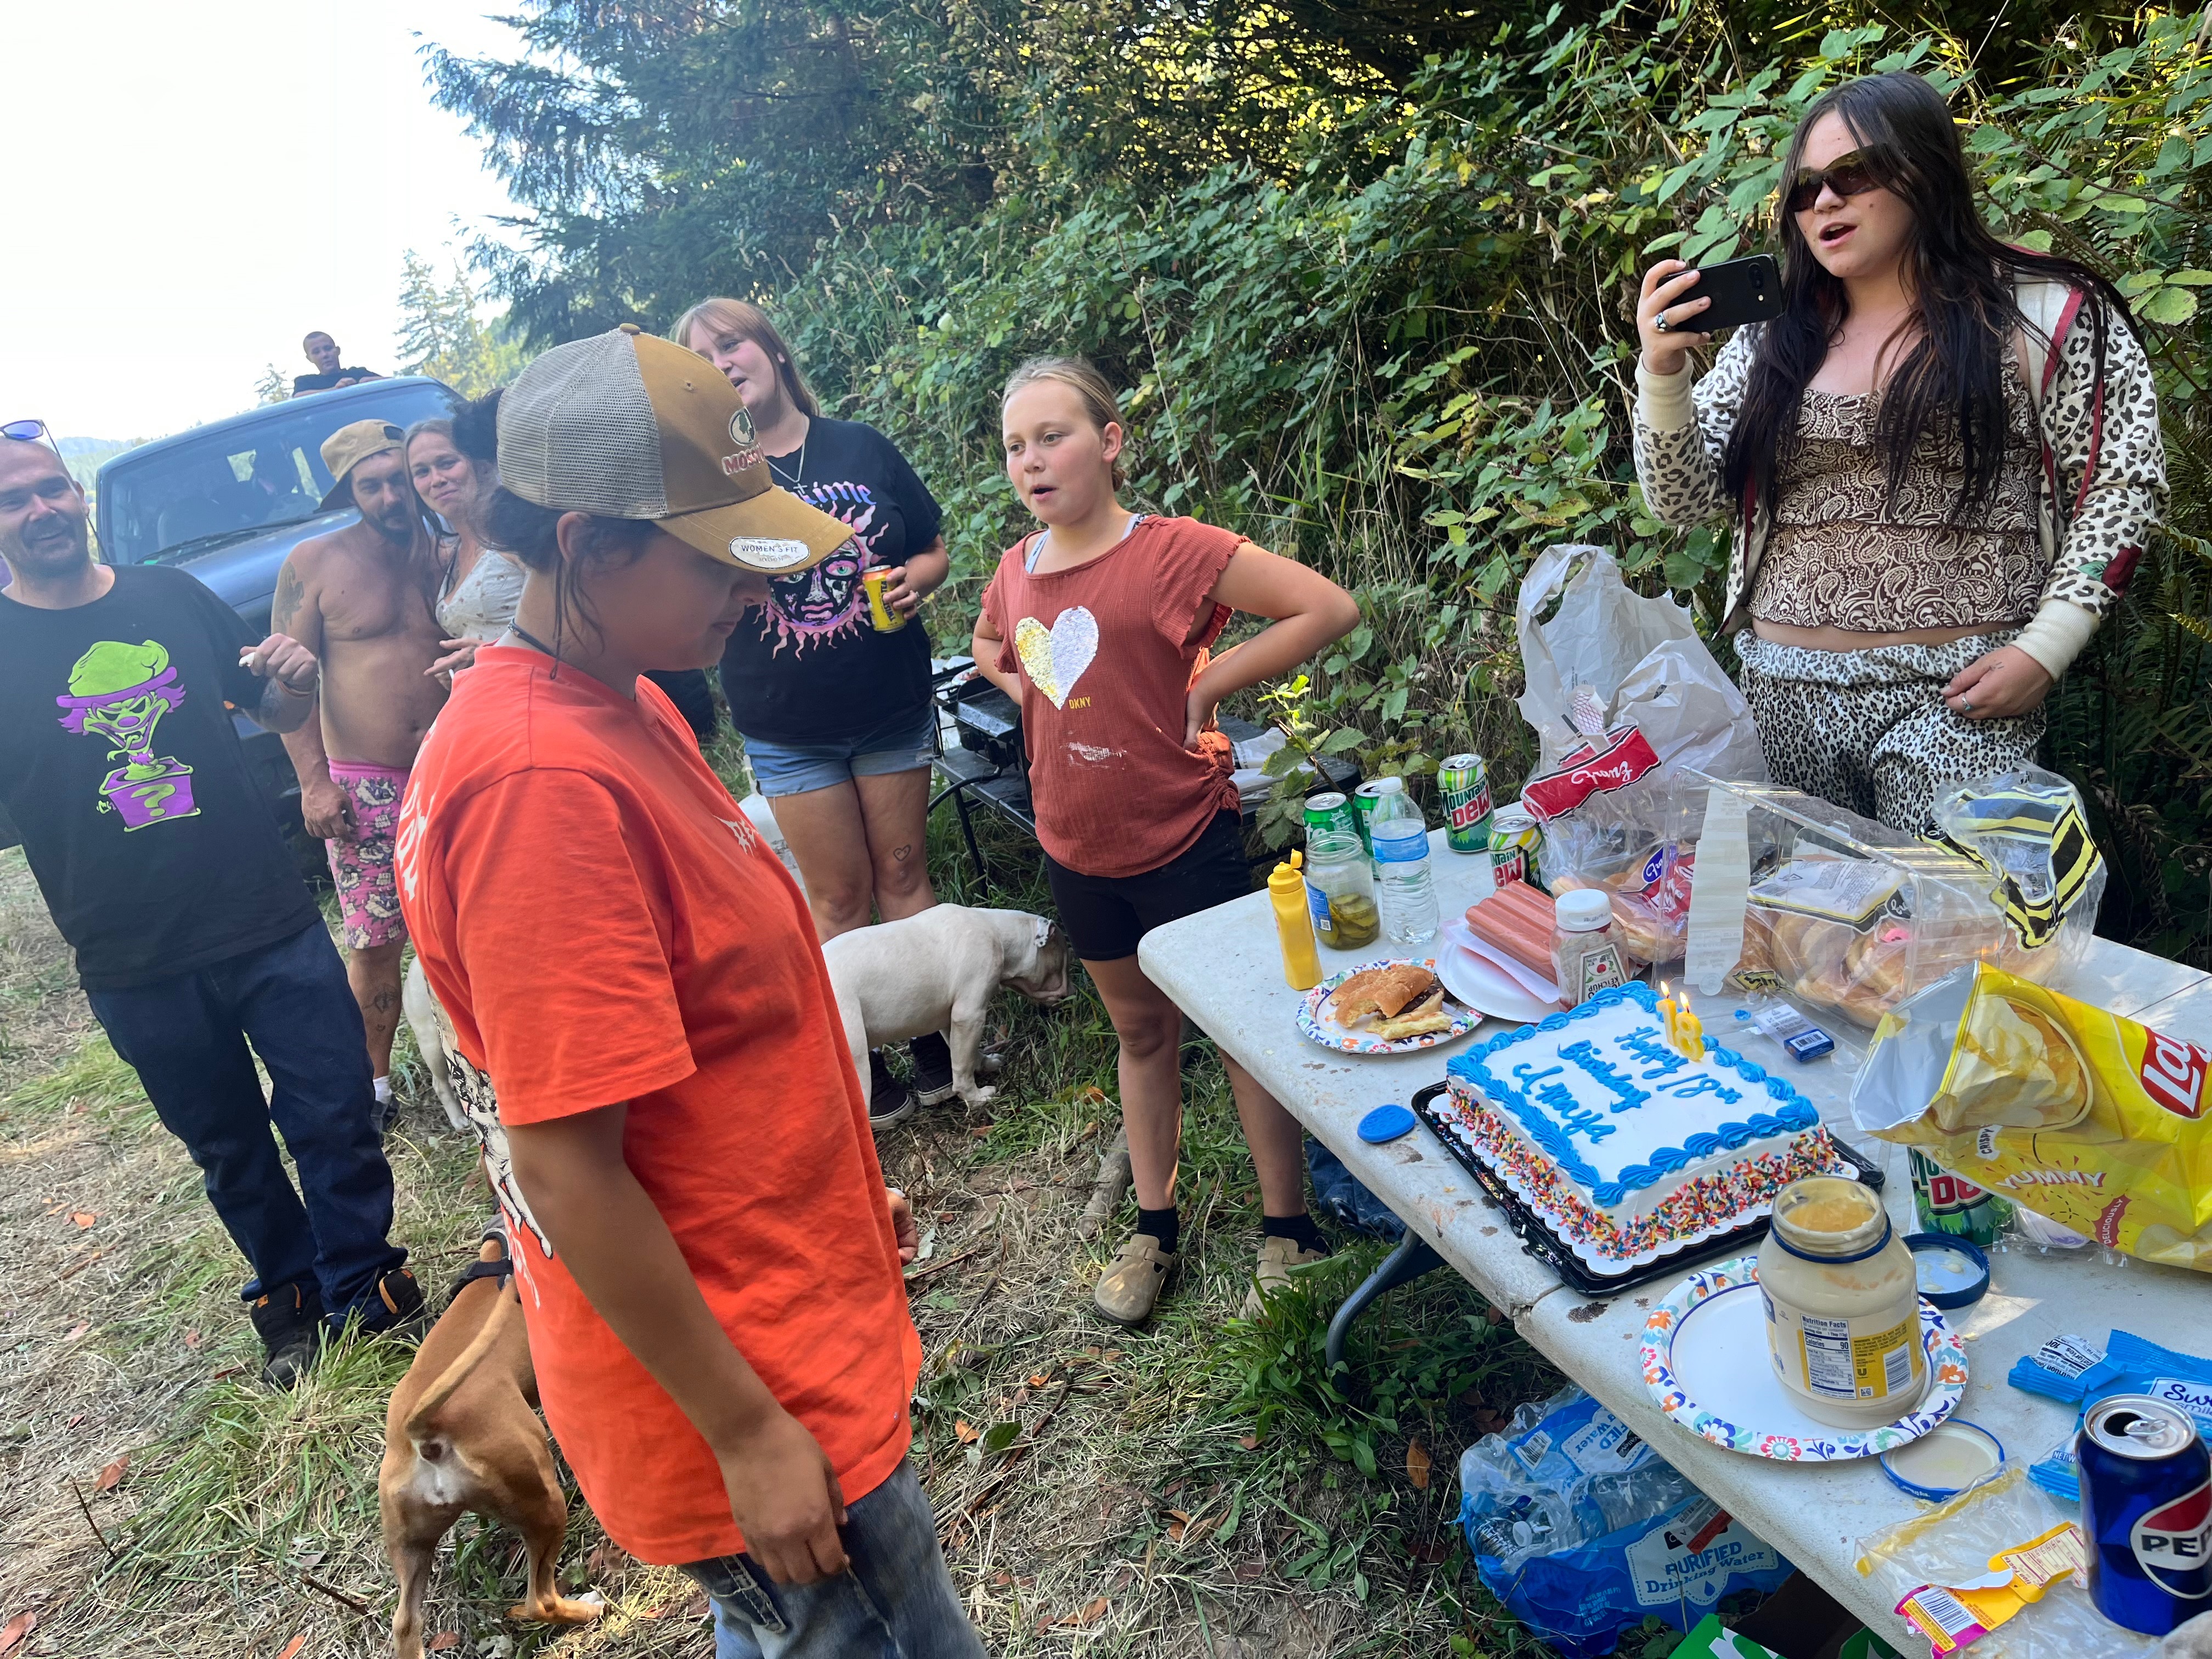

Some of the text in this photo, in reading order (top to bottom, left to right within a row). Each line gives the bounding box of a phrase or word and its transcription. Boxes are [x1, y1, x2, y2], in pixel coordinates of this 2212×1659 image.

[1069, 696, 1092, 710] DKNY
[1571, 760, 1633, 785] Franz
[1655, 998, 1705, 1063] 18
[1613, 1026, 1690, 1080] Happy
[1556, 1040, 1652, 1113] Birthday
[1979, 1127, 1994, 1155] CRISPY
[1994, 1170, 2107, 1190] YUMMY
[2103, 1198, 2124, 1245] DELICIOUSLY
[1802, 1315, 1827, 1327] Nutrition
[1805, 1337, 1825, 1348] Calories
[1840, 1341, 1849, 1350] 90
[2066, 1347, 2094, 1366] Calories
[2052, 1450, 2075, 1464] NET W
[1664, 1541, 1742, 1576] PURIFIED
[1645, 1551, 1764, 1593] Drinking Water
